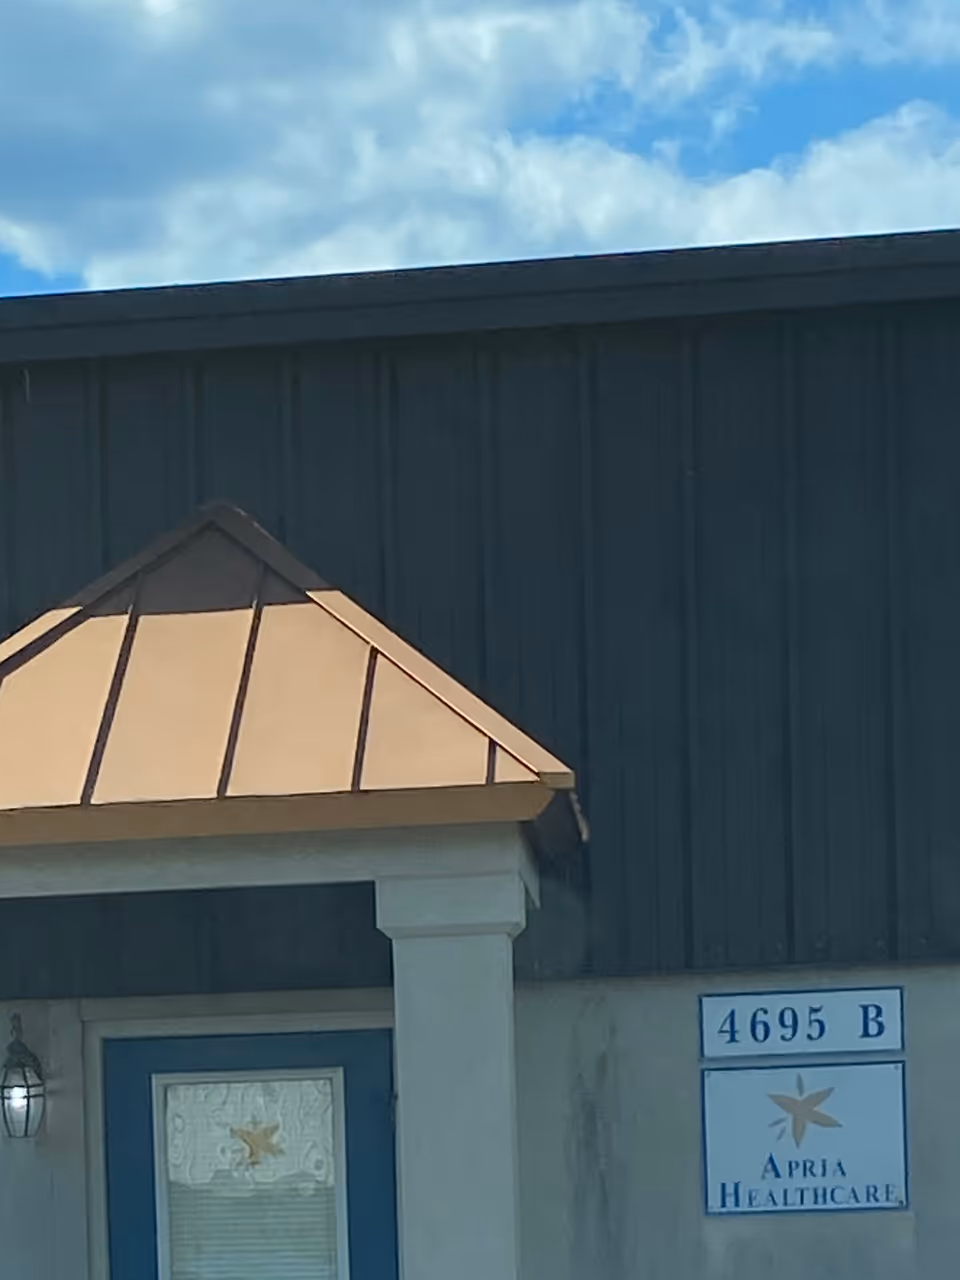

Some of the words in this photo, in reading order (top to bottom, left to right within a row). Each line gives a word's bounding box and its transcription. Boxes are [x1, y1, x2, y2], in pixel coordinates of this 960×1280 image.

[717, 1005, 826, 1044] 4695
[858, 1003, 885, 1039] B
[761, 1153, 847, 1180] APRIA
[720, 1181, 898, 1209] HEALTHCARE
